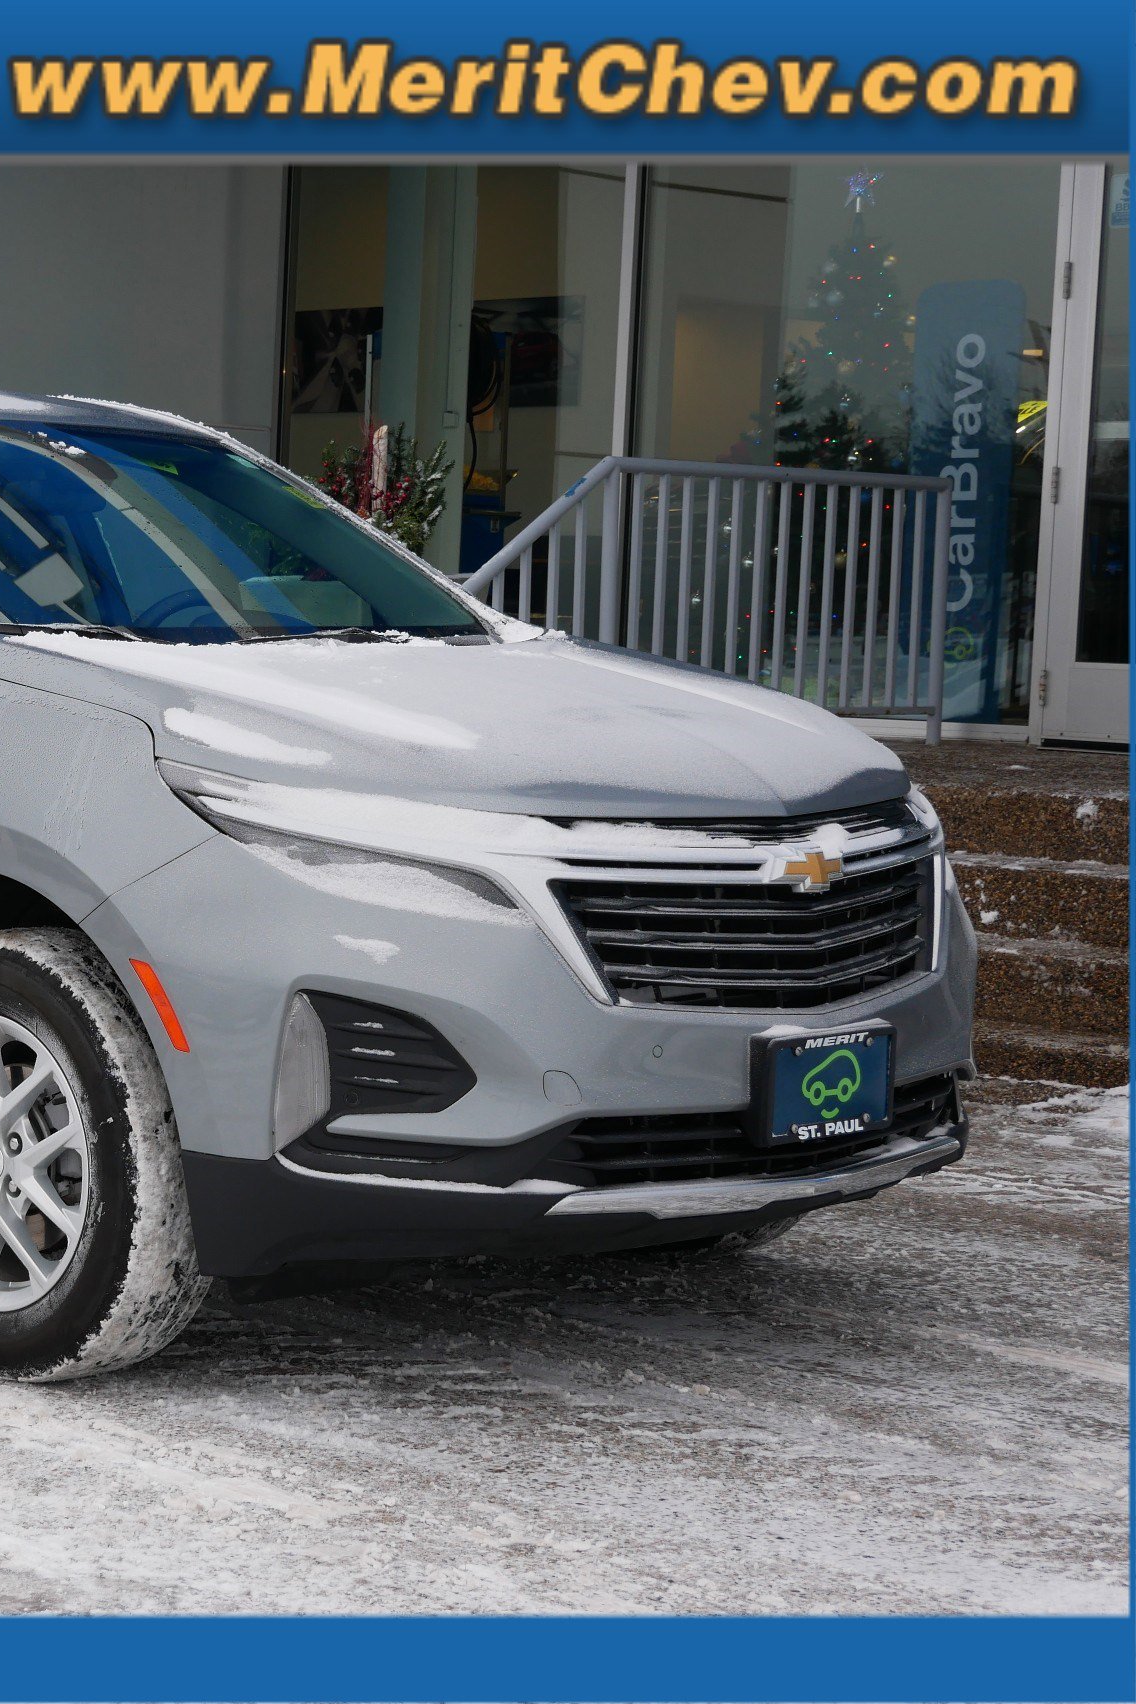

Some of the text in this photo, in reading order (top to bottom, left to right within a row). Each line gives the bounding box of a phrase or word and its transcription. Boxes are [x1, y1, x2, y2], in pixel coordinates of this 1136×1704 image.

[939, 333, 986, 612] CarBravo
[804, 1032, 869, 1050] MERIT
[797, 1118, 864, 1140] ST. PAUL
